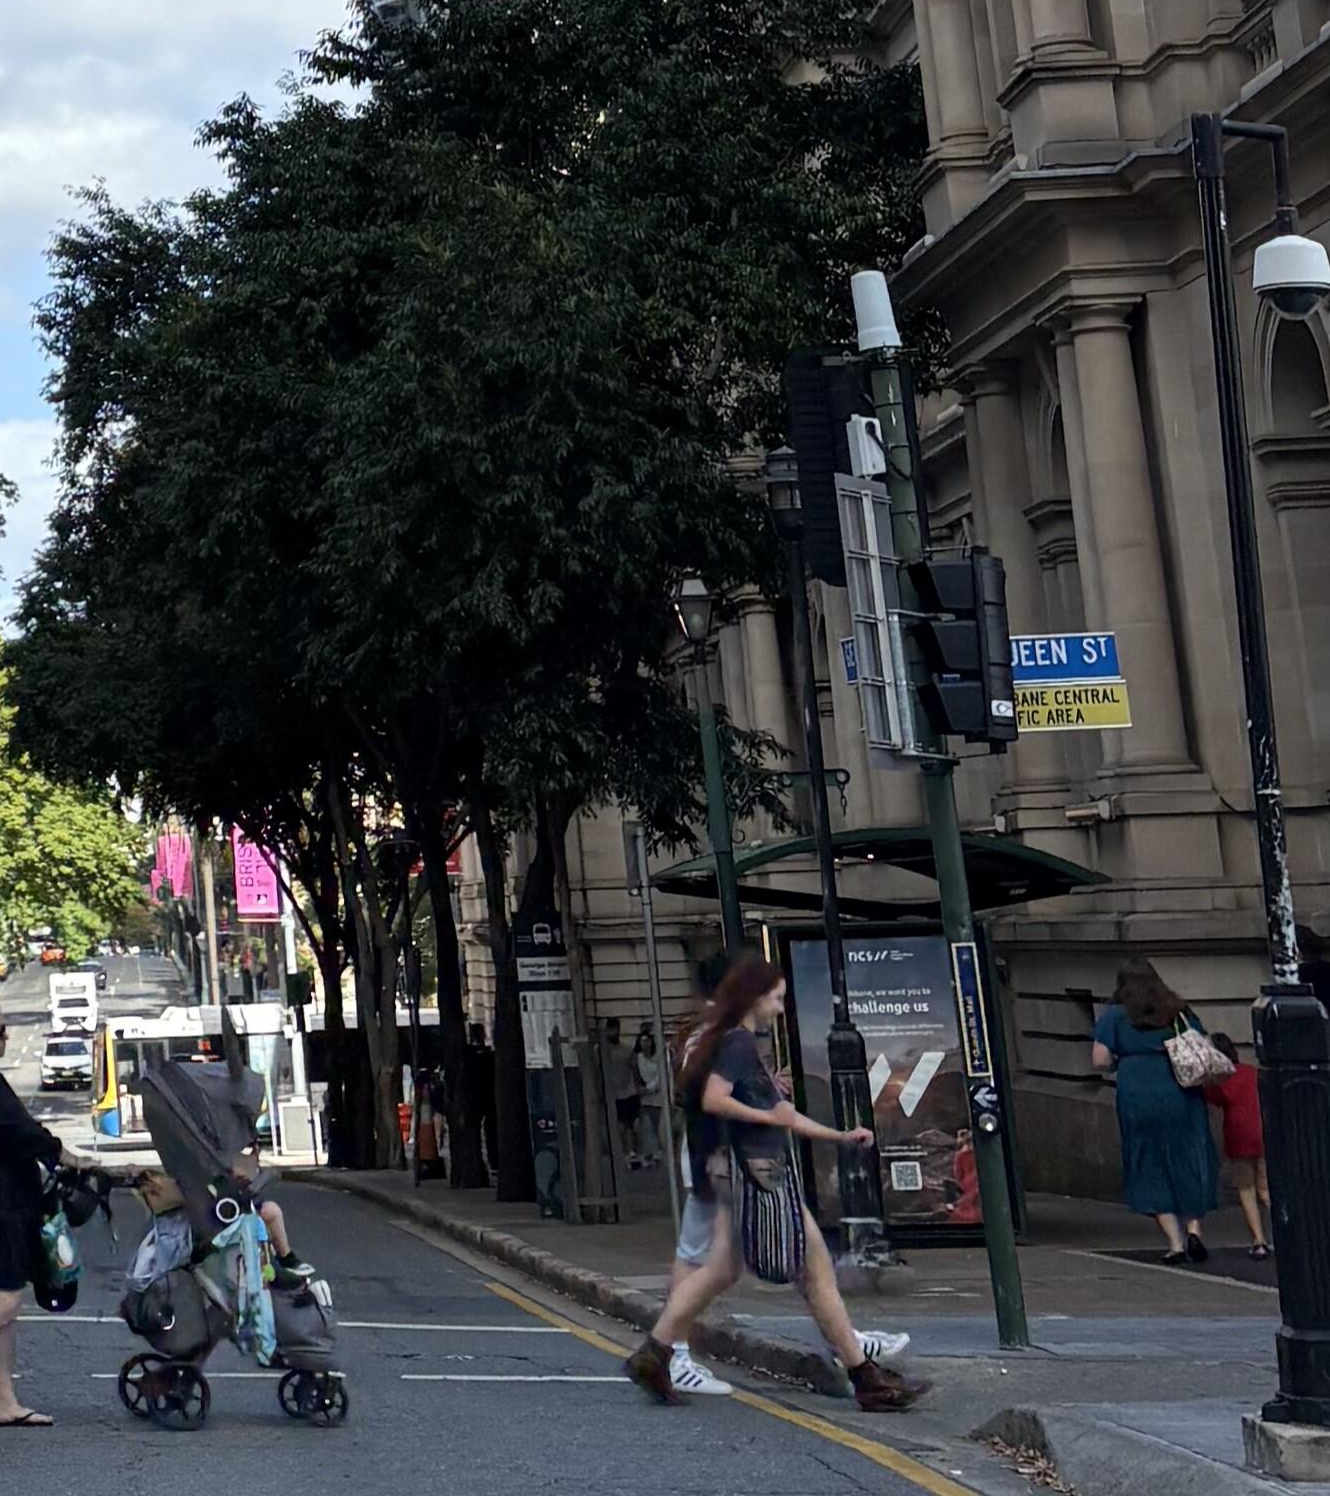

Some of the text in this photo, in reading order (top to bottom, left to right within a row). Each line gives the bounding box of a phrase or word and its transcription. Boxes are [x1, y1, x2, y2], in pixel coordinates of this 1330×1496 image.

[1010, 637, 1109, 667] UEEN ST
[1014, 687, 1121, 707] BANE CENTRAL
[1046, 708, 1085, 726] AREA
[237, 845, 254, 887] BRIS
[914, 1002, 930, 1013] us
